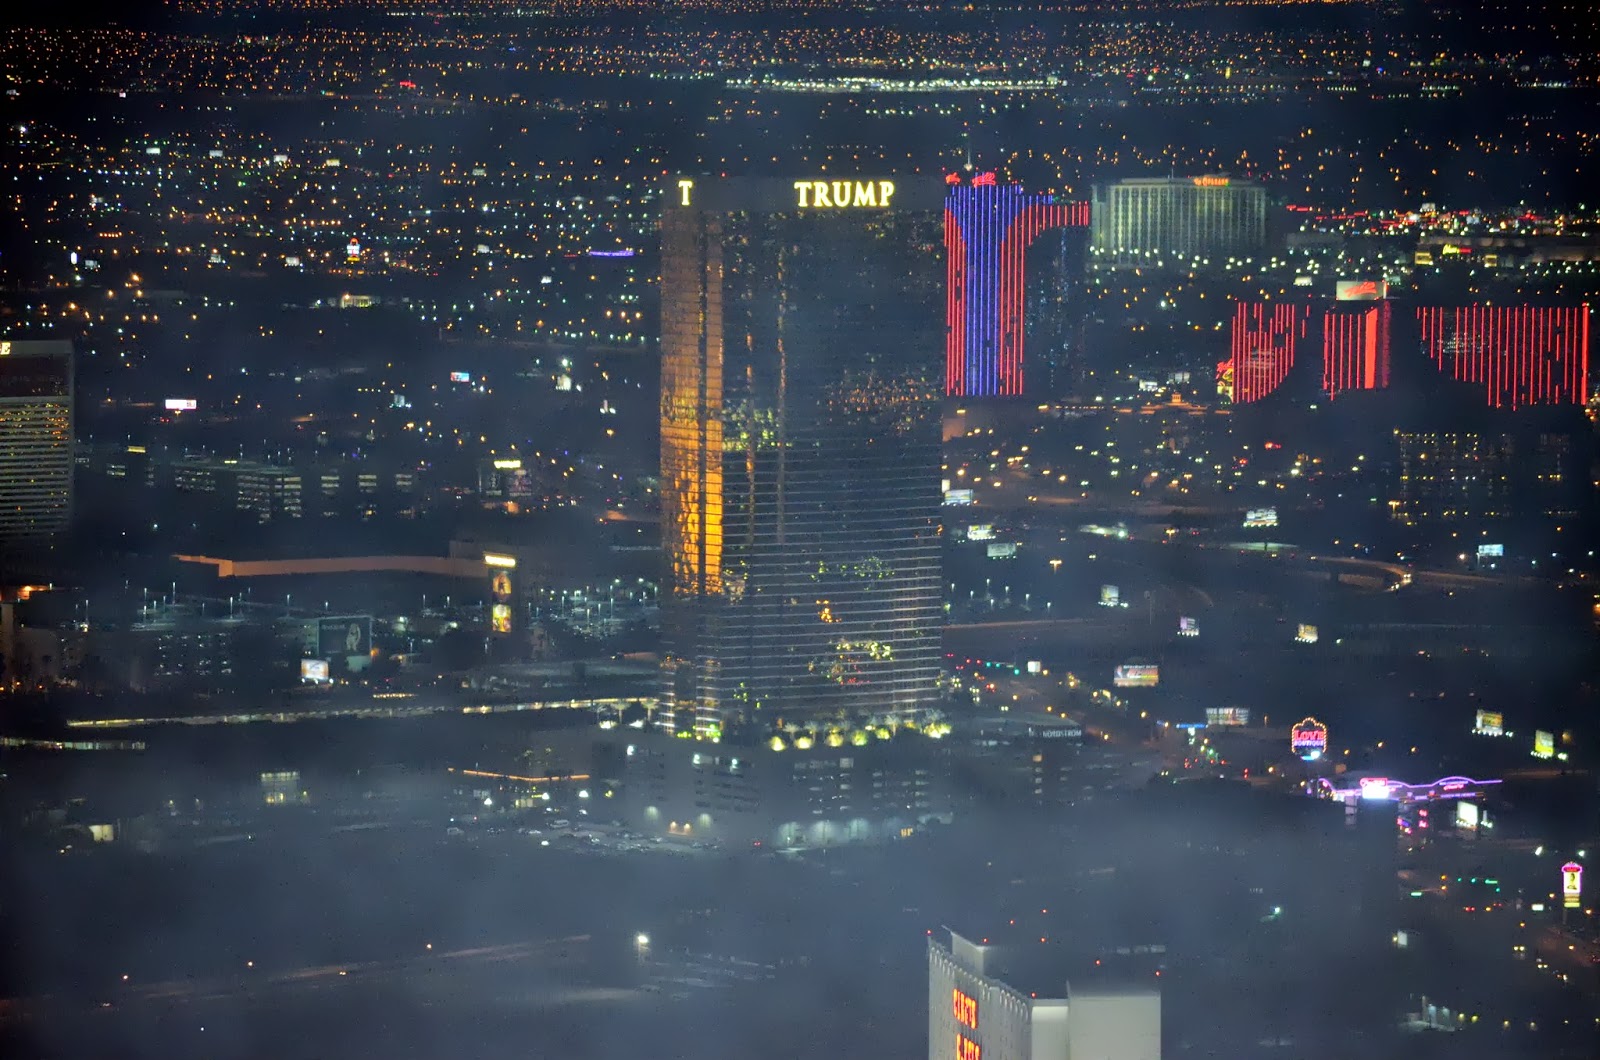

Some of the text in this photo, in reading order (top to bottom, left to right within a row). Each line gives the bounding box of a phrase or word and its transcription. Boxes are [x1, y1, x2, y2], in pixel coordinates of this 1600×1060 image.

[677, 180, 693, 206] T
[793, 180, 895, 207] TRUMP
[0, 342, 11, 355] E
[1042, 729, 1082, 738] NORDSTROM
[1294, 730, 1324, 740] LOVE
